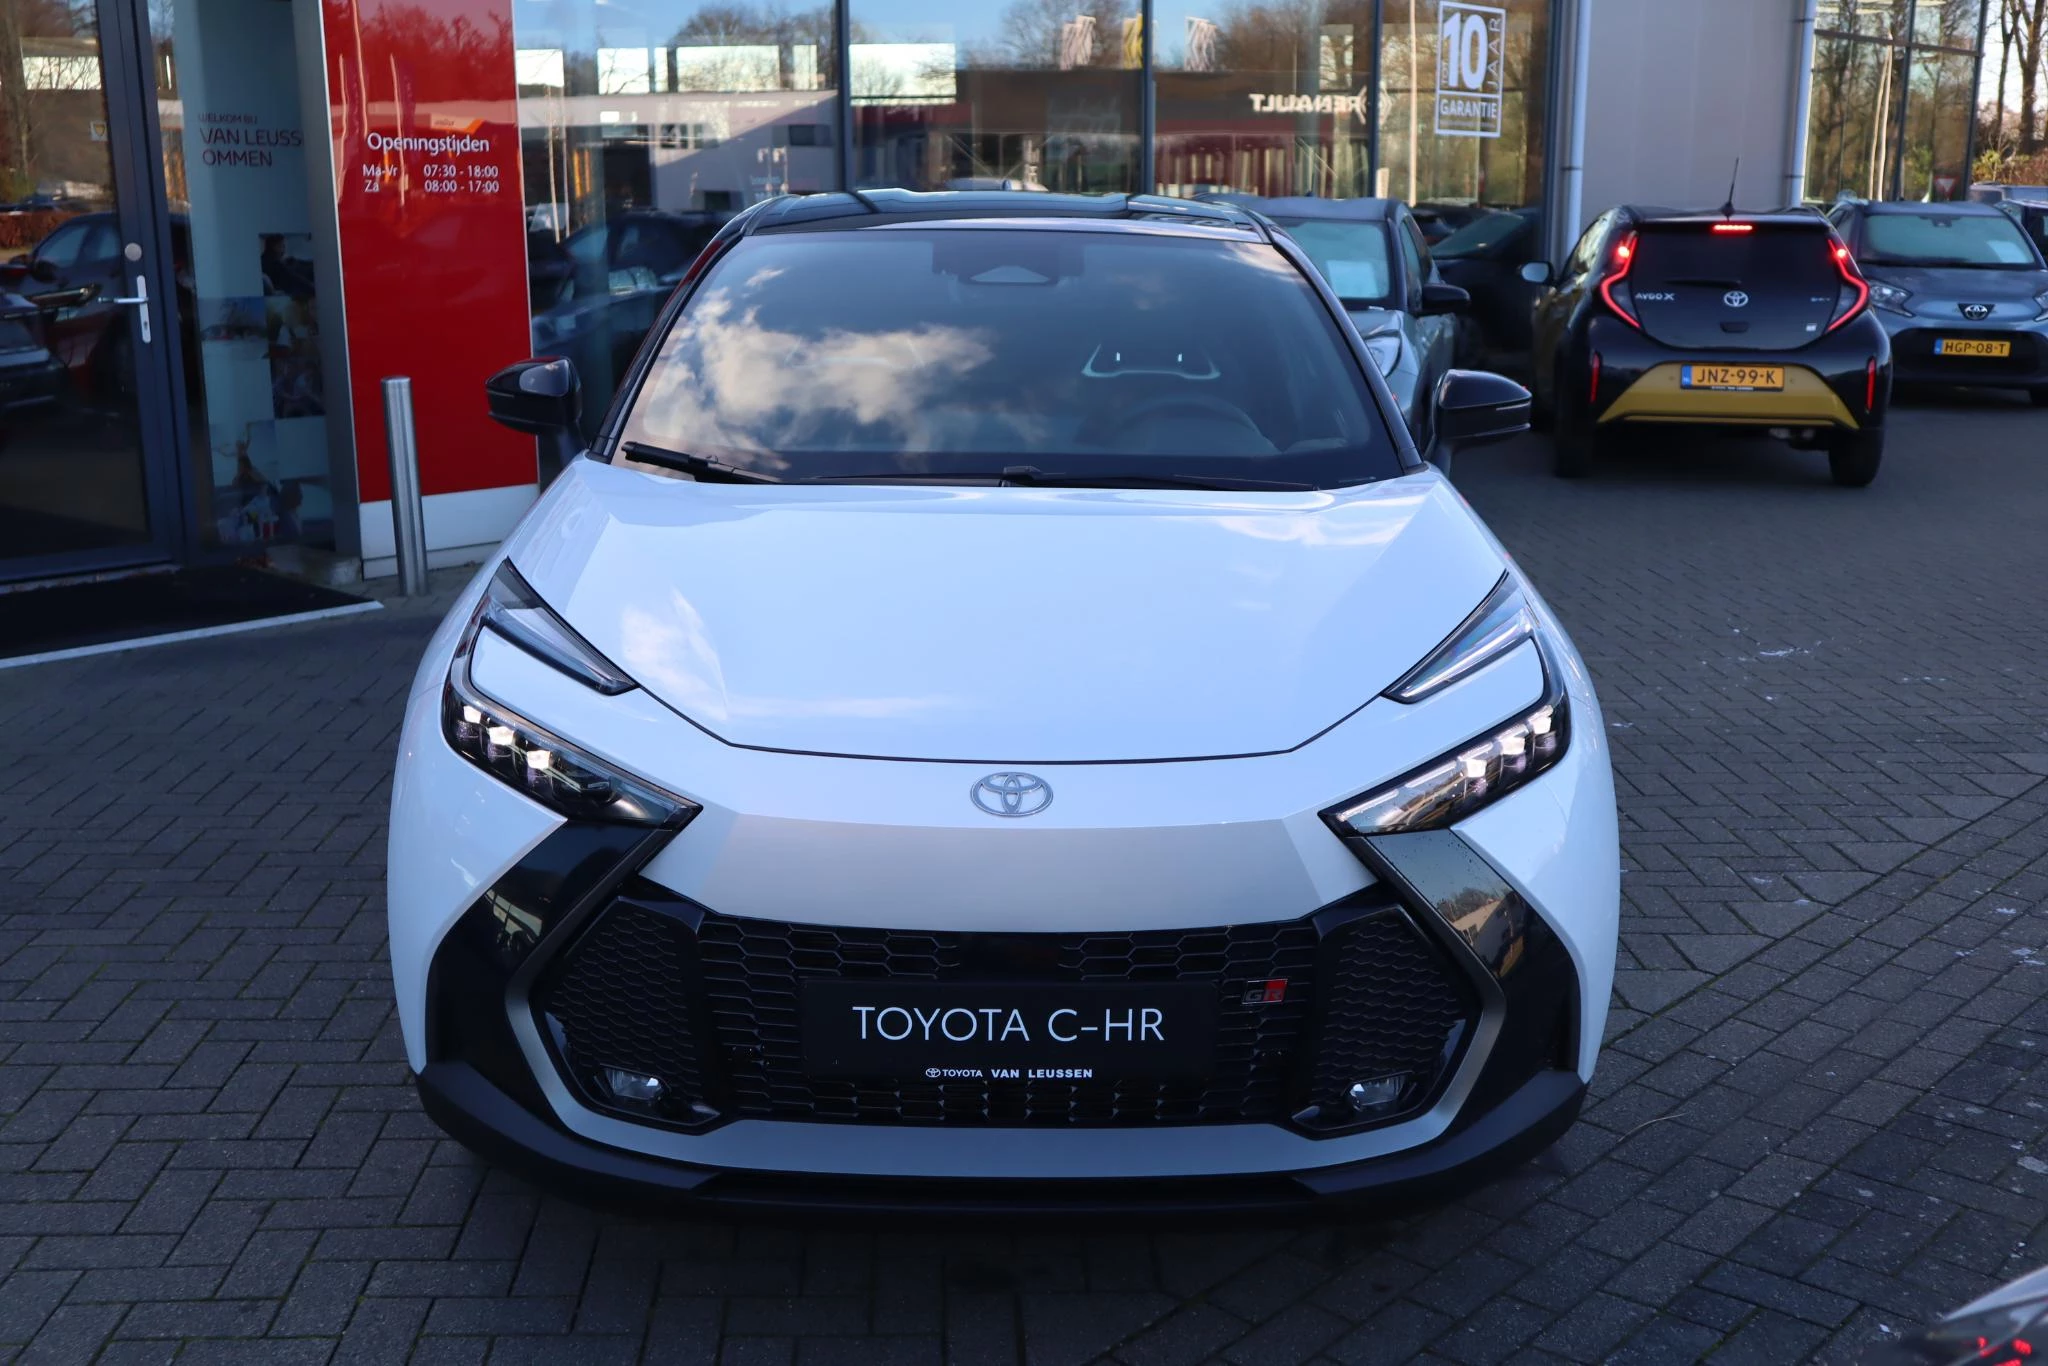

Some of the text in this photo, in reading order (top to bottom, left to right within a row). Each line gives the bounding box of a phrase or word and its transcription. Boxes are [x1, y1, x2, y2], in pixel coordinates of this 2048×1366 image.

[1443, 11, 1488, 89] 10
[1487, 18, 1501, 88] JAAR
[1440, 99, 1497, 118] GARANTIE
[200, 127, 240, 145] VAN
[367, 132, 490, 156] Openingstijden
[202, 148, 273, 167] OMMEN
[362, 163, 398, 177] Ma-Vr
[423, 164, 456, 177] 07:30
[468, 165, 499, 178] 18:00
[364, 180, 380, 192] Za
[424, 180, 457, 193] 08:00
[468, 180, 499, 193] 17:00
[1663, 292, 1675, 301] X
[1944, 342, 2006, 354] HGP-08-T
[1697, 369, 1775, 384] JNZ-99-K
[852, 1006, 1165, 1042] TOYOTA C-HR
[942, 1068, 1093, 1078] TOYOTA VAN LEUSSEN
